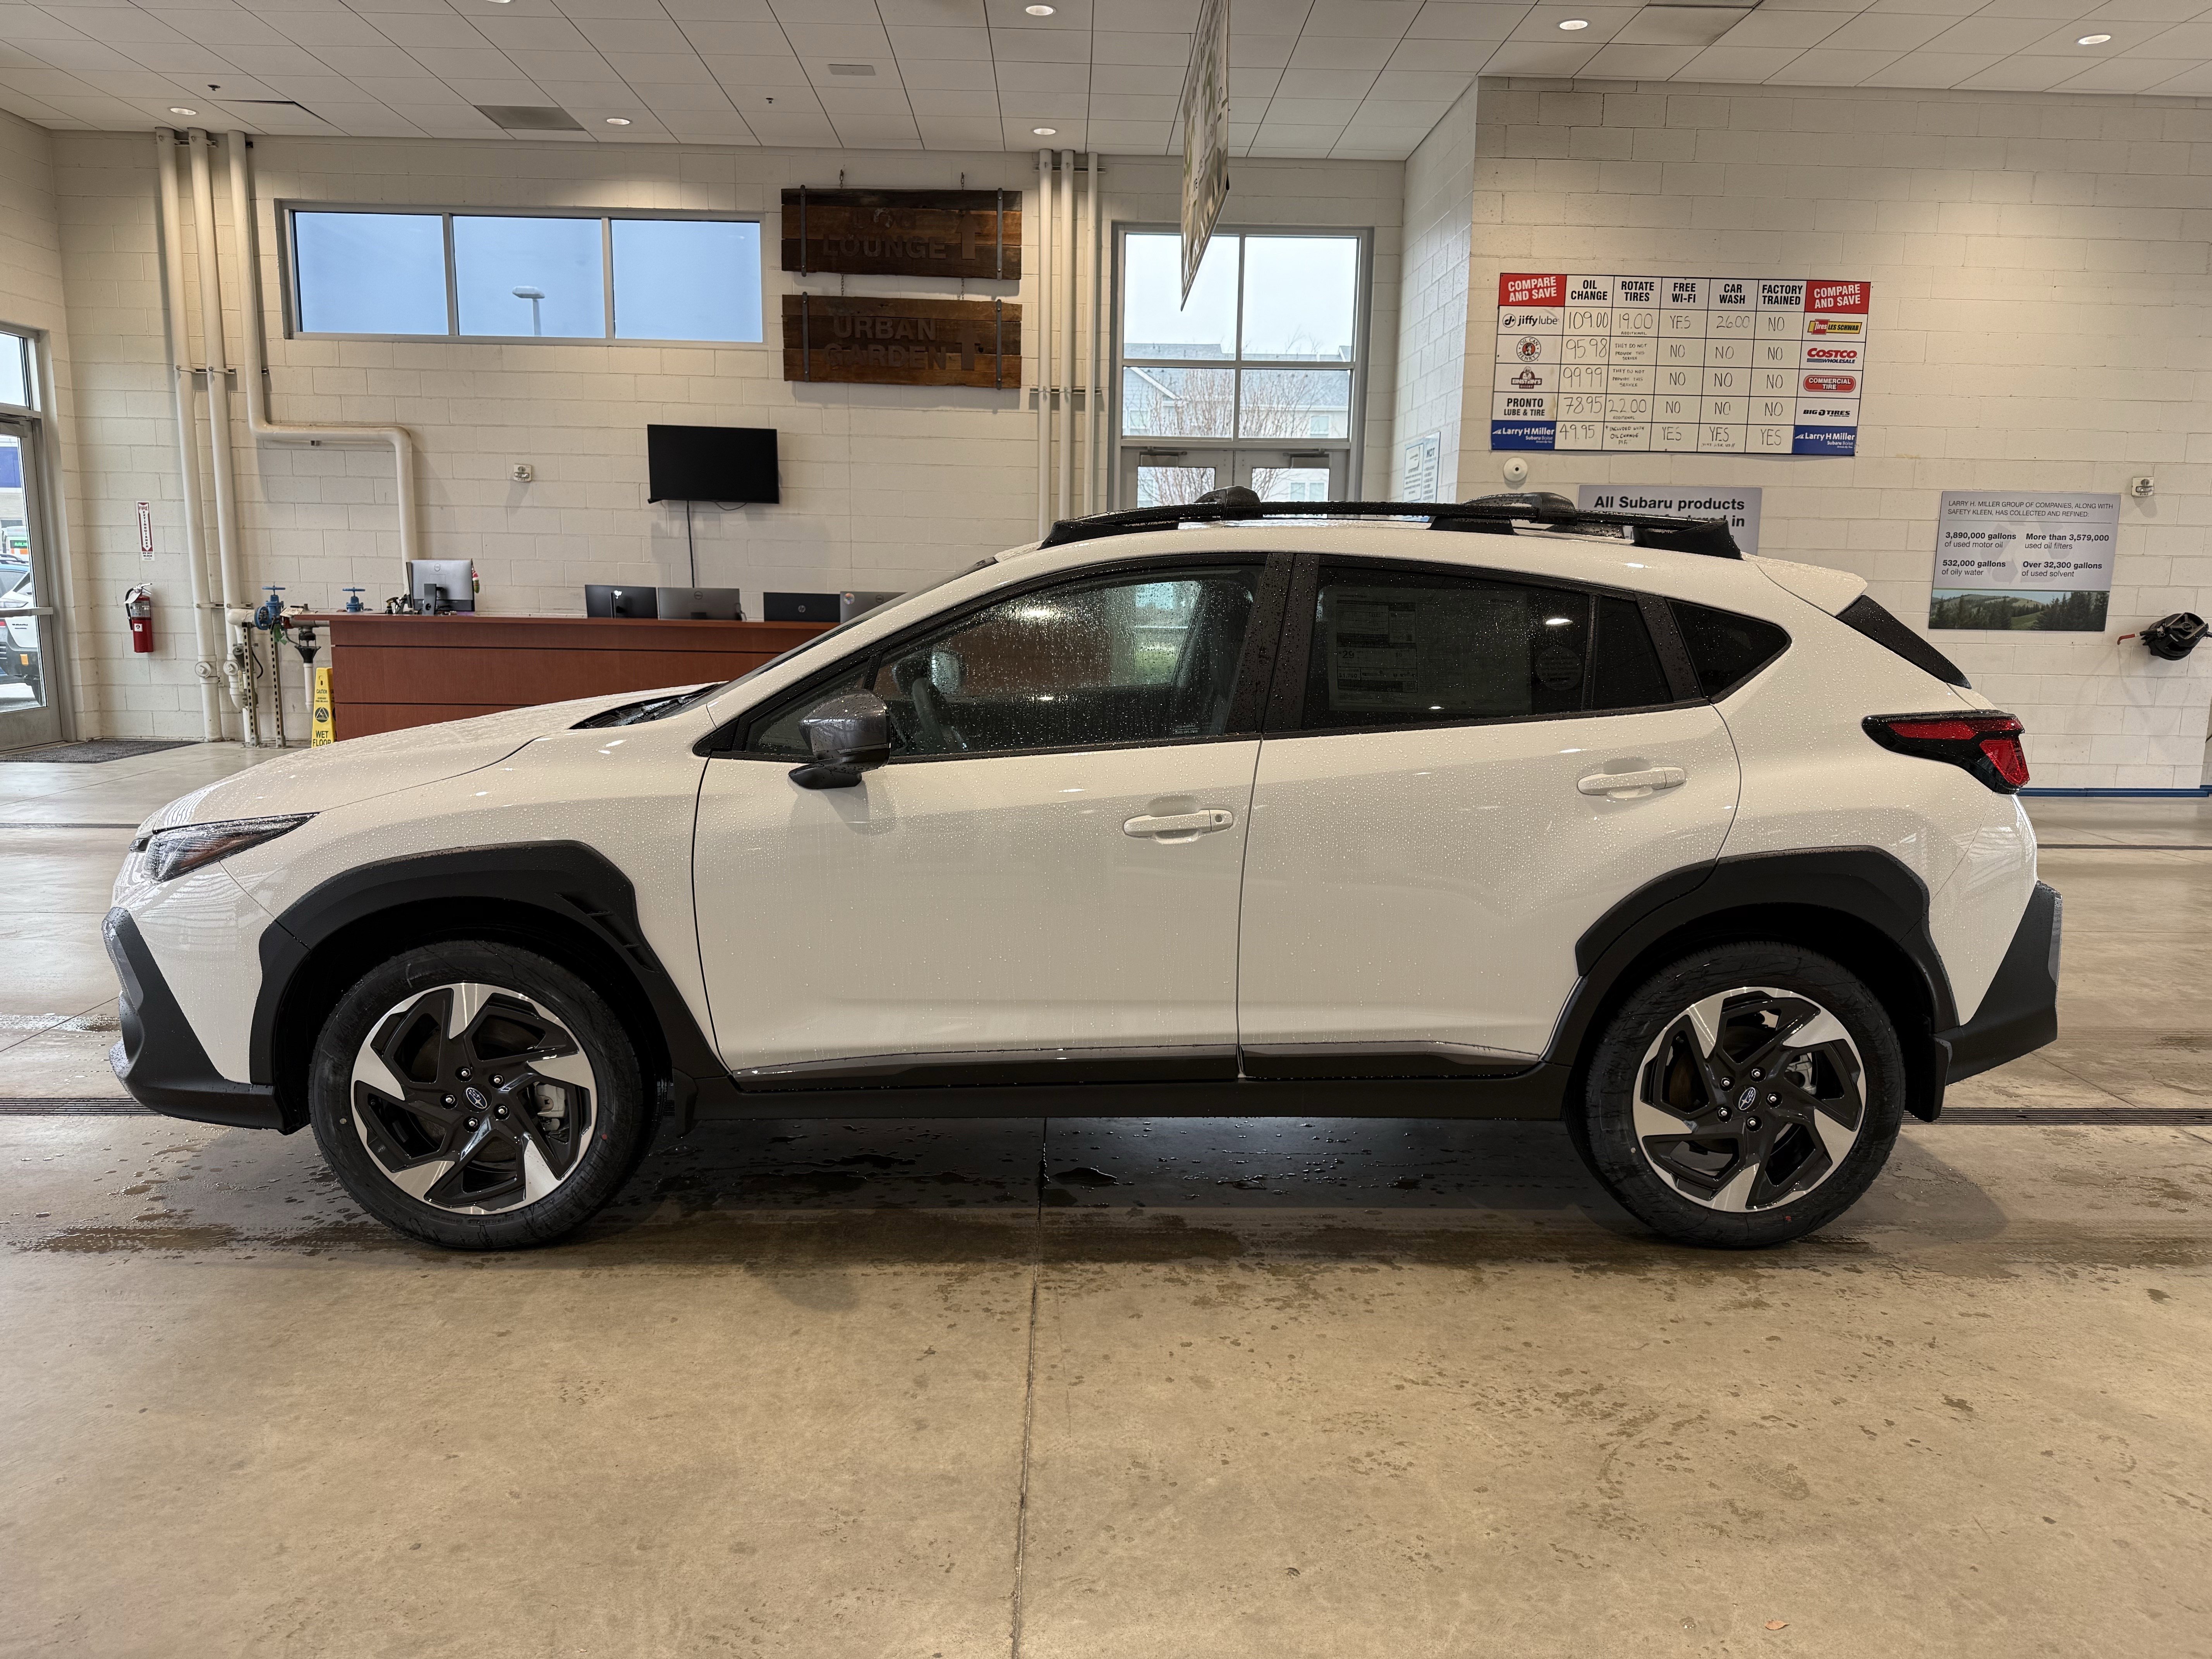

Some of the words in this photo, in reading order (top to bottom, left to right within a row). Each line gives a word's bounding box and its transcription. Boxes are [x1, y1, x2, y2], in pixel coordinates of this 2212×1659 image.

[823, 234, 946, 259] LOUNGE
[1508, 276, 1556, 291] COMPARE
[1583, 280, 1597, 289] OIL
[1621, 281, 1654, 291] ROTATE
[1673, 283, 1696, 292] FREE
[1724, 283, 1742, 293] CAR
[1762, 284, 1803, 294] FACTORY
[1509, 292, 1529, 302] AND
[1532, 287, 1557, 299] SAVE
[1571, 290, 1607, 300] CHANGE
[1624, 292, 1650, 301] TIRES
[1672, 293, 1696, 303] WI-FI
[1814, 284, 1860, 298] COMPARE
[1719, 294, 1745, 304] WASH
[1762, 295, 1801, 305] TRAINED
[1815, 298, 1834, 309] AND
[1837, 294, 1861, 306] SAVE
[1569, 311, 1608, 329] 109.00
[1619, 313, 1653, 329] 19.00
[1670, 315, 1691, 329] YES
[1768, 317, 1784, 331] NO
[1814, 321, 1827, 330] Tires
[833, 316, 936, 341] URBAN
[1529, 338, 1539, 346] CAN
[825, 343, 946, 370] GARDEN
[1670, 344, 1685, 358] NO
[1716, 346, 1734, 359] NO
[1768, 347, 1783, 361] NO
[1807, 348, 1857, 359] COSTCO
[1563, 367, 1602, 388] 9999
[1670, 372, 1685, 386] NO
[1714, 373, 1733, 387] NO
[1767, 374, 1783, 389] NO
[1507, 398, 1543, 407] PRONTO
[1666, 401, 1681, 414] NO
[1715, 402, 1730, 415] NO
[1765, 402, 1783, 416] NO
[1503, 428, 1523, 436] Larry
[1559, 424, 1595, 440] 49.95
[1662, 426, 1681, 441] YES
[1709, 426, 1729, 442] YES
[1760, 429, 1781, 446] YES
[1805, 433, 1825, 441] Larry
[1594, 496, 1614, 508] All
[1619, 496, 1673, 508] Subaru
[1678, 498, 1745, 511] products
[1732, 515, 1745, 527] in
[1946, 532, 1985, 540] 3,890,000
